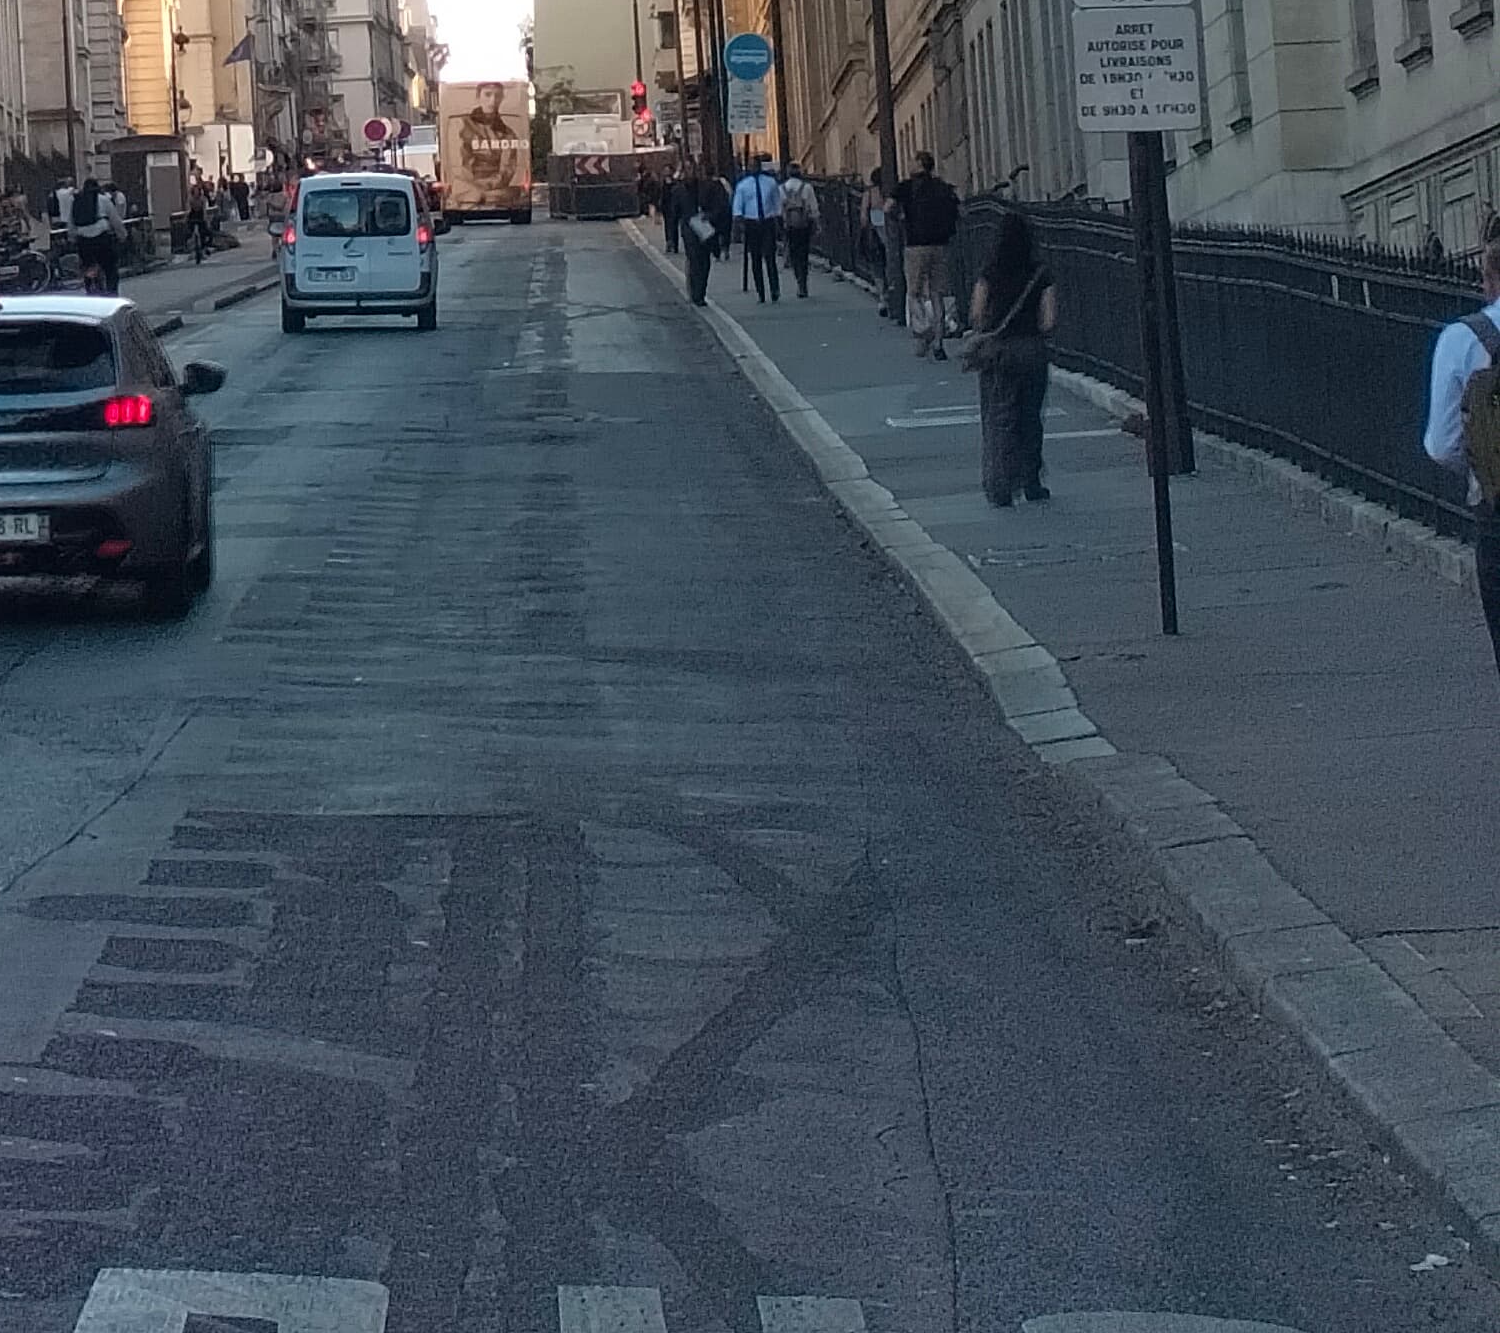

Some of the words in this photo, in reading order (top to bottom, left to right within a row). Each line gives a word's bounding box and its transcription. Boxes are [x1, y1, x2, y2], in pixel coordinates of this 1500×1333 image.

[1115, 23, 1153, 35] ARRET
[1087, 39, 1146, 52] AUTORISE
[1150, 38, 1184, 50] POUR
[1099, 55, 1172, 68] LIVRAISONS
[1080, 73, 1096, 84] DE
[1080, 105, 1097, 117] DE
[1141, 104, 1149, 114] A
